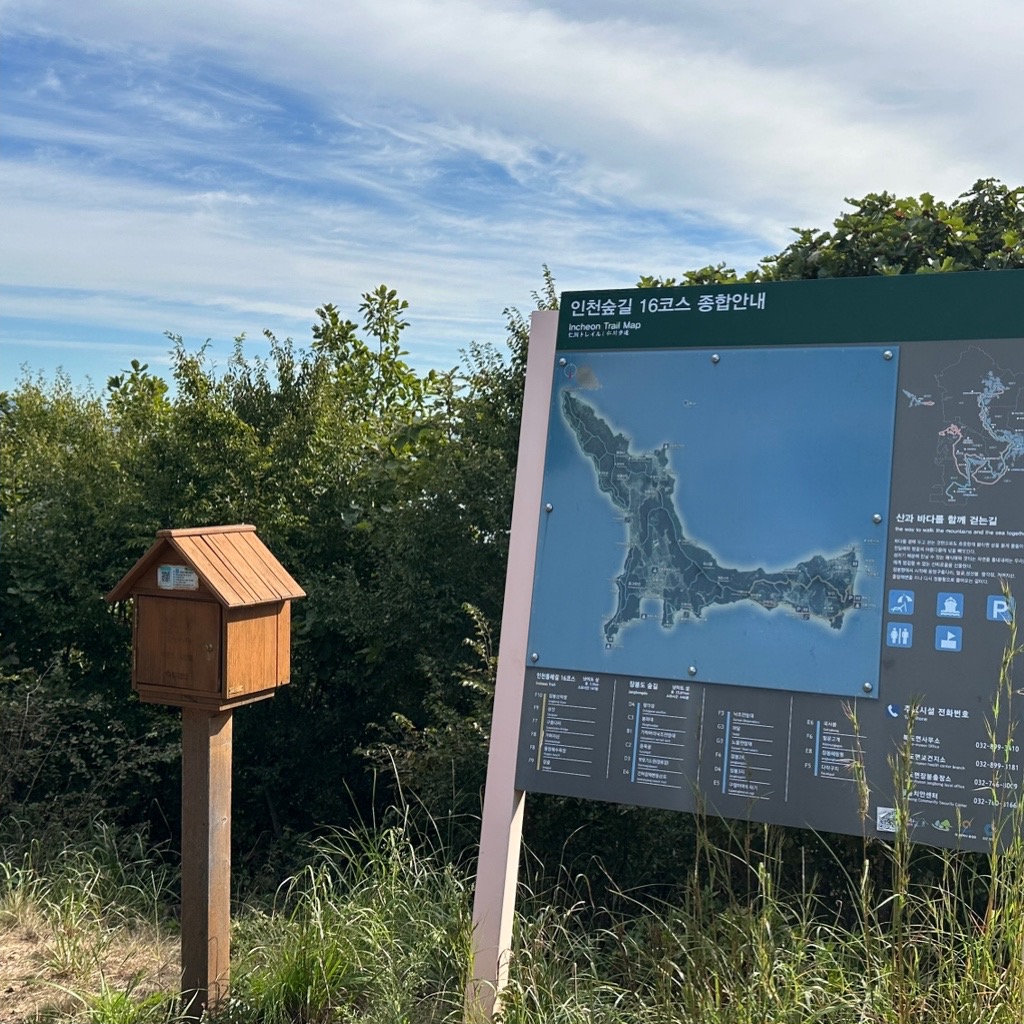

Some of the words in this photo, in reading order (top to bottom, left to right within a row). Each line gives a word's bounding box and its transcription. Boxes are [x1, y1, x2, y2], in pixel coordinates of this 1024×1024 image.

[571, 298, 632, 317] 인천숲길
[640, 296, 692, 314] 16코스
[697, 292, 767, 312] 종합안내
[568, 322, 601, 332] Incheon
[604, 321, 621, 331] Trail
[623, 321, 641, 332] Map
[896, 513, 914, 523] 산과
[917, 514, 944, 525] 바다를
[948, 515, 966, 525] 함께
[969, 516, 997, 527] 걷는길
[938, 708, 970, 719] 전화번호
